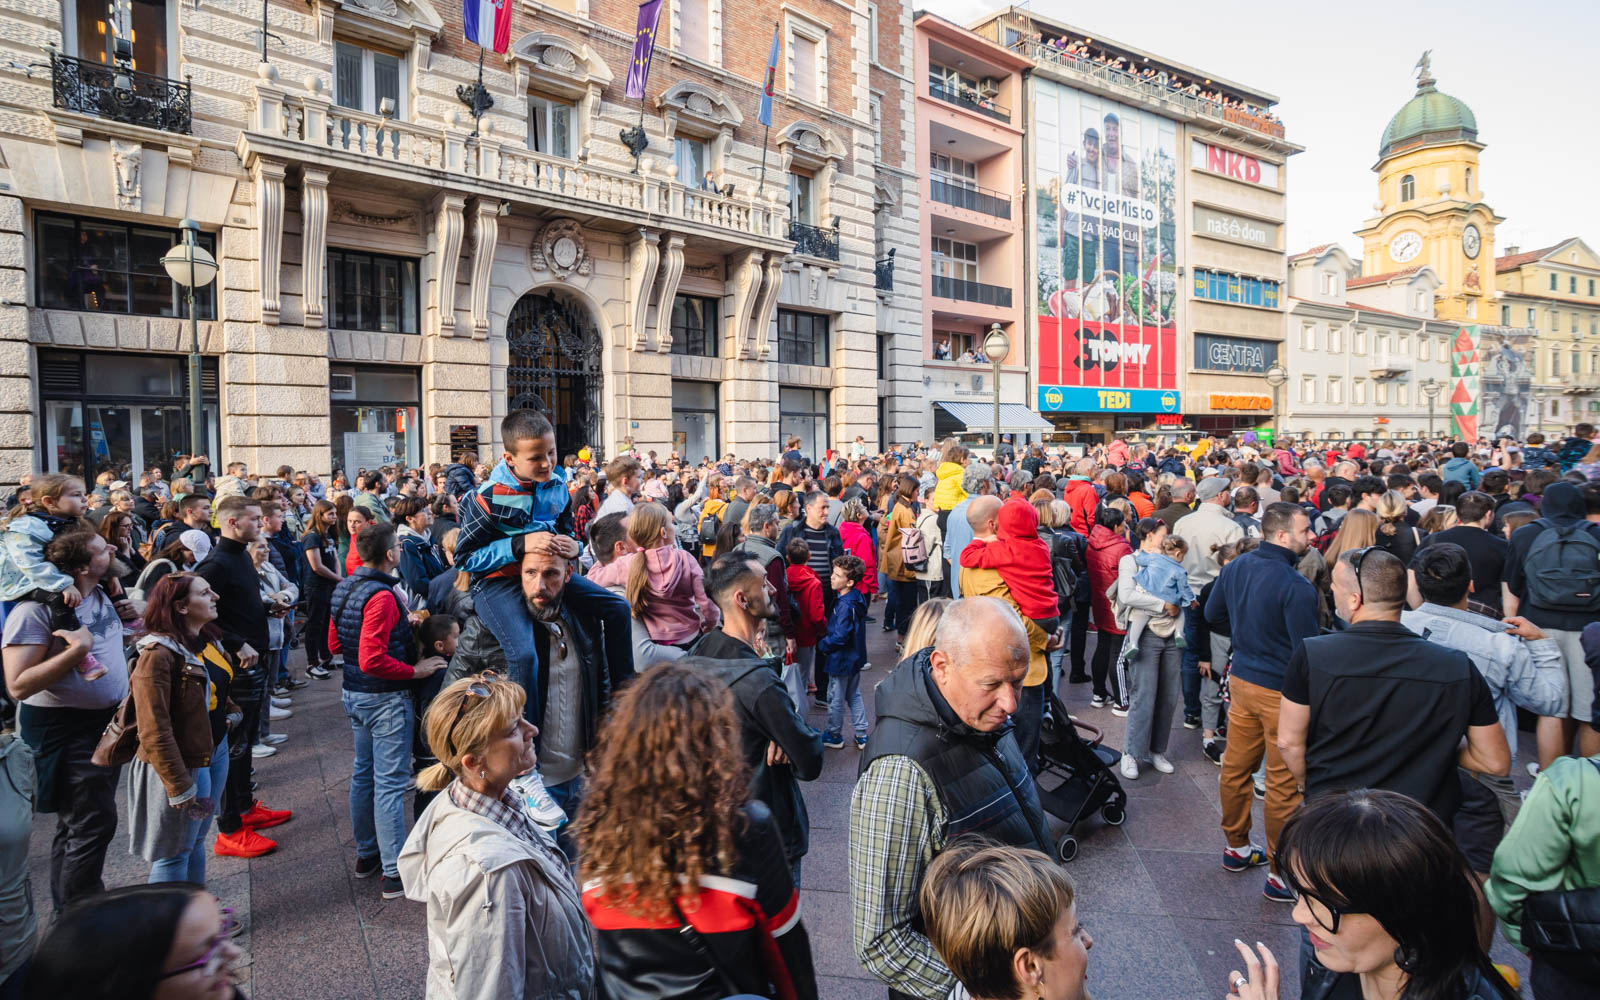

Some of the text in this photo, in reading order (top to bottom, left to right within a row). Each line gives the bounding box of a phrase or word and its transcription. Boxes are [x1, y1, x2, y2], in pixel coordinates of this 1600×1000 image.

[1208, 145, 1261, 184] NKD
[1081, 221, 1094, 234] ZA
[1207, 217, 1266, 243] naš dom
[1088, 339, 1152, 365] TOMMY
[1209, 342, 1264, 368] CENTRA
[1097, 390, 1131, 409] TEDi
